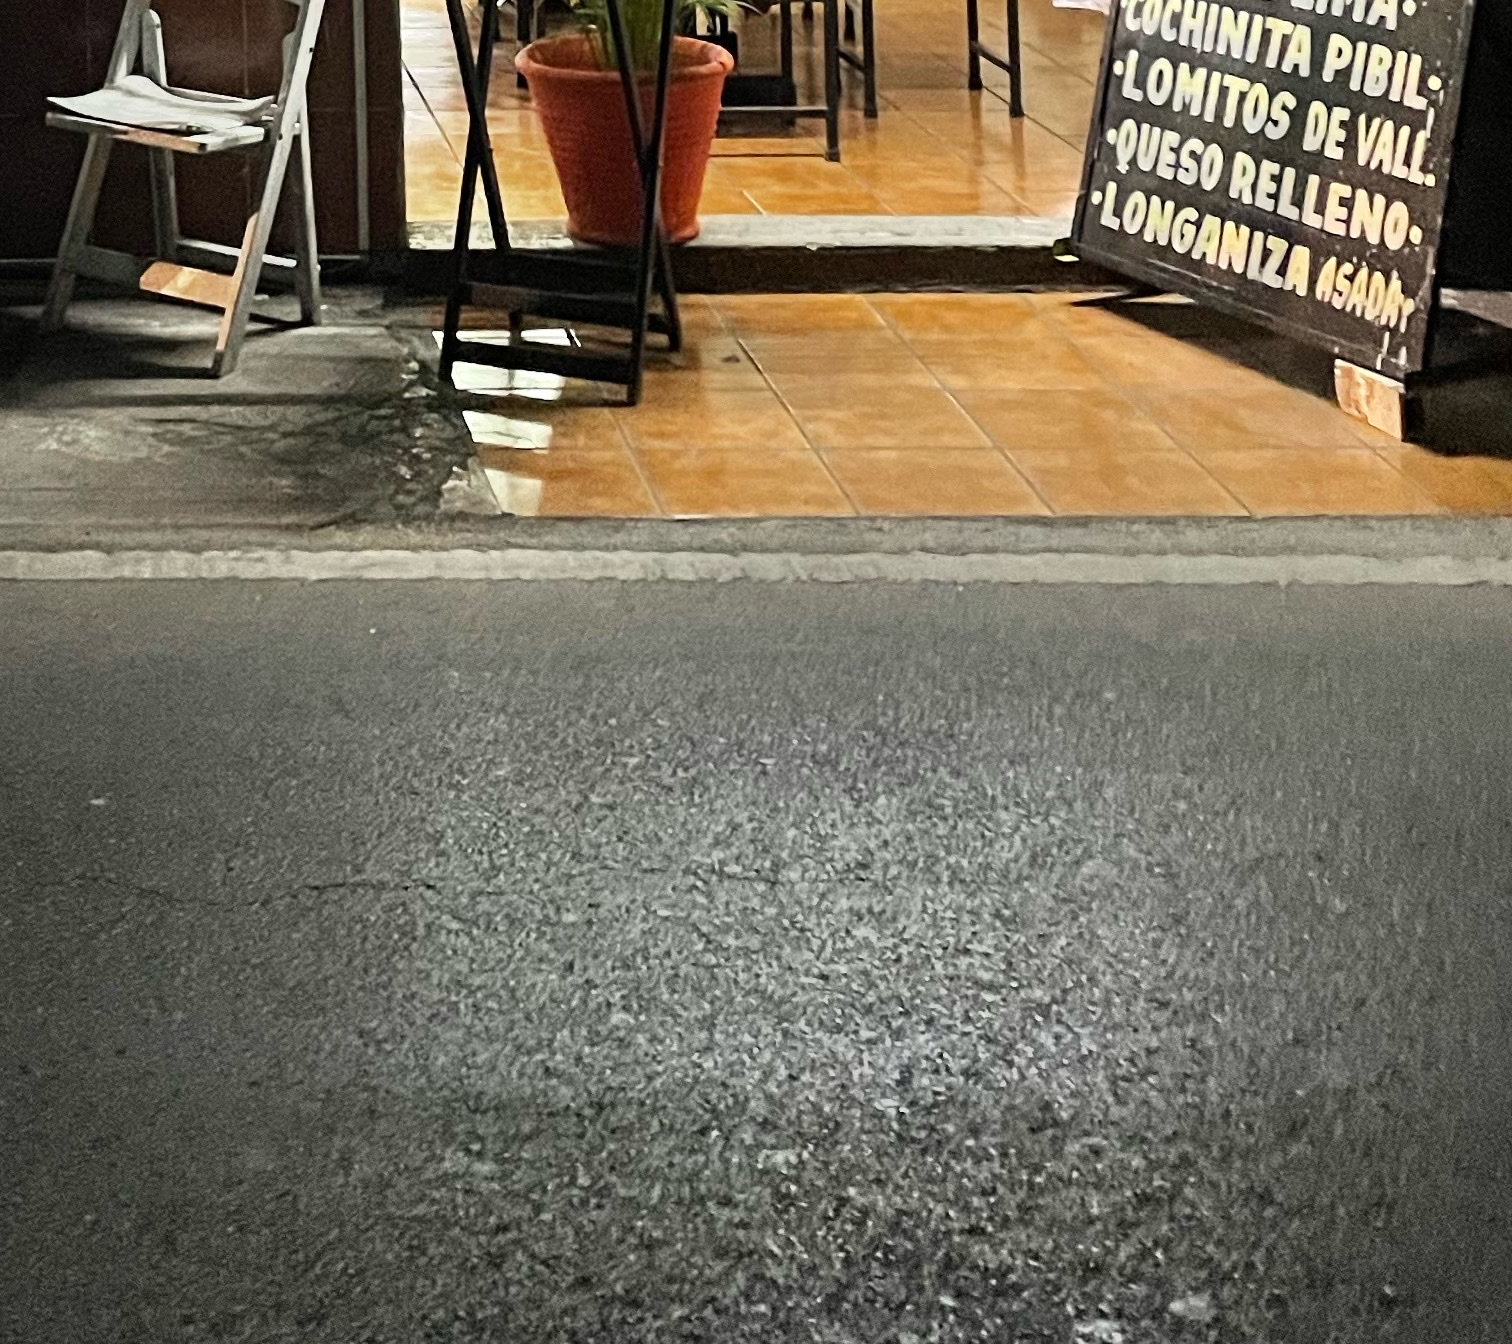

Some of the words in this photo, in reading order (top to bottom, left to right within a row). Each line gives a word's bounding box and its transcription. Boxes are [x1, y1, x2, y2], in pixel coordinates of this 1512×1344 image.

[1121, 49, 1297, 141] LOMITOS
[1302, 100, 1351, 161] DE
[1322, 33, 1429, 112] PIBIL
[1115, 118, 1224, 192] QUESO
[1229, 151, 1410, 251] RELLENO
[1100, 181, 1311, 298] LONGANIZA
[1315, 256, 1406, 331] ASADA
